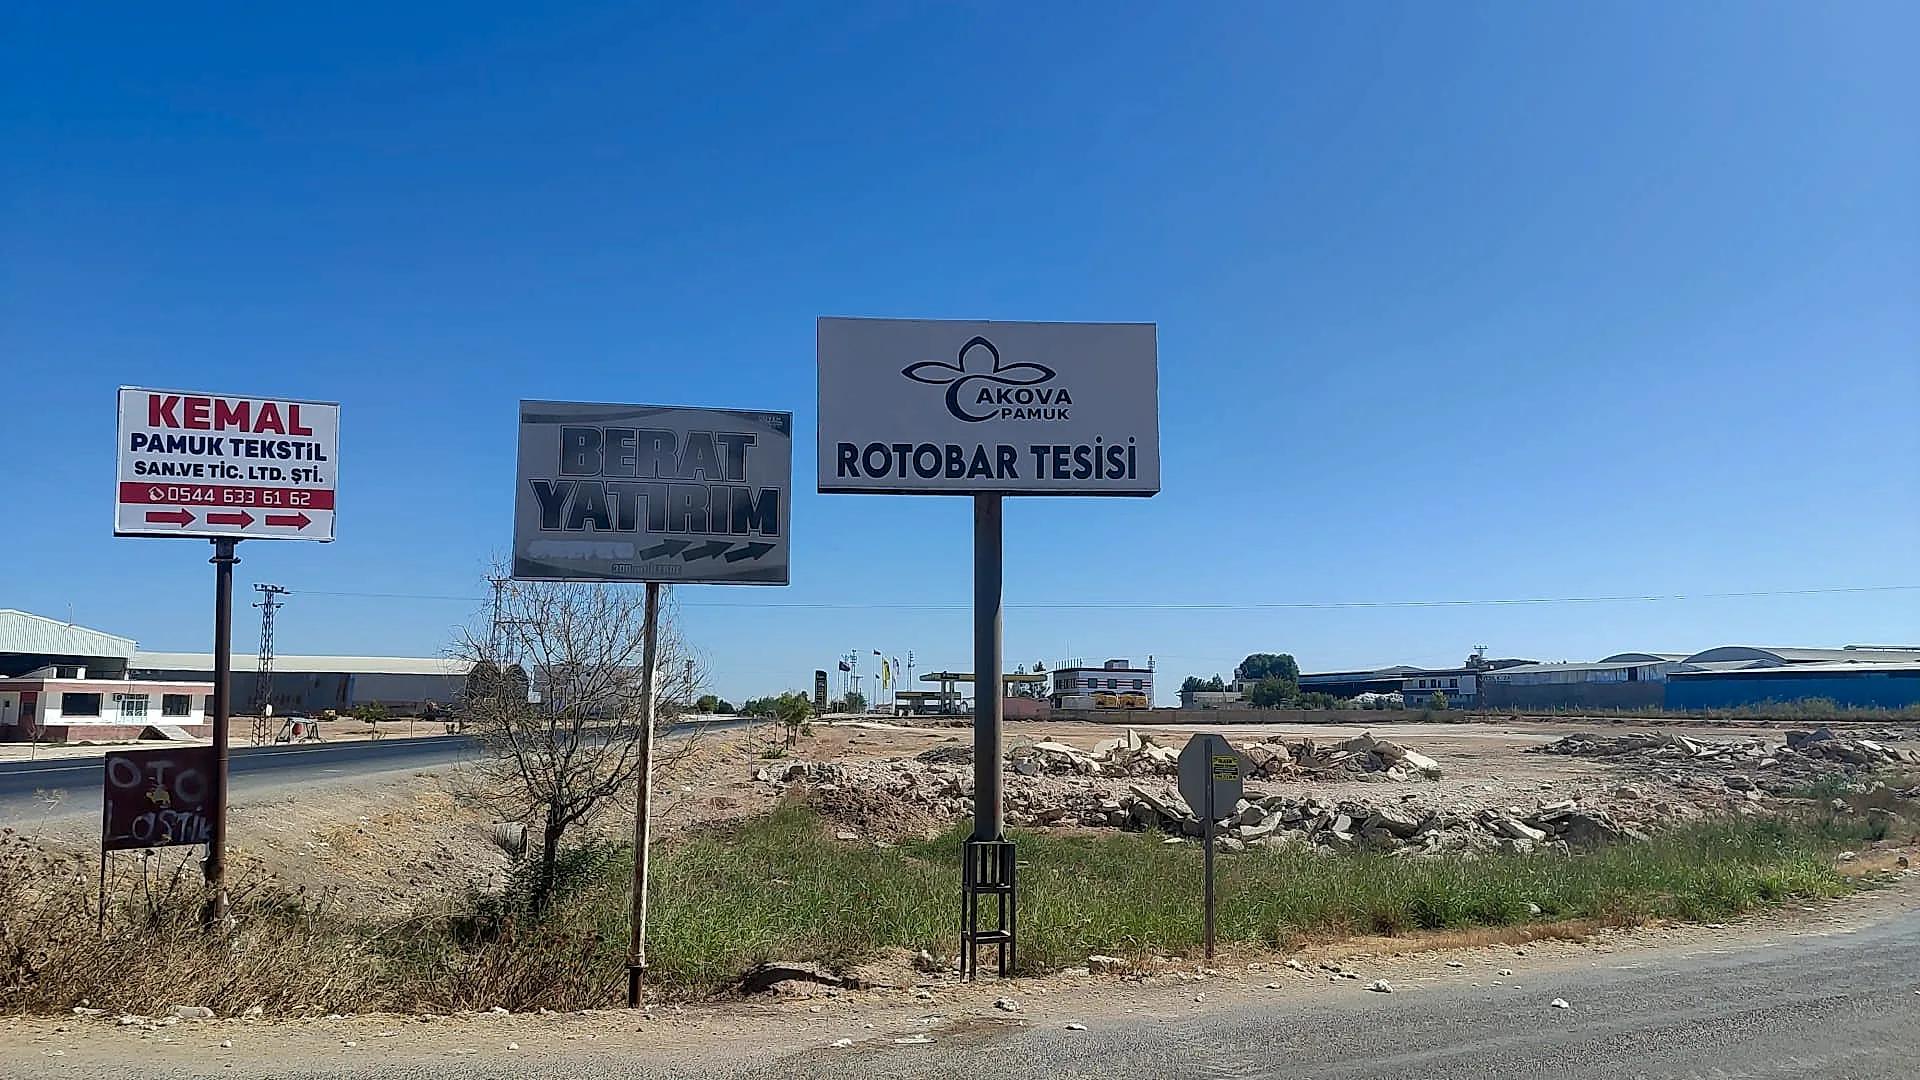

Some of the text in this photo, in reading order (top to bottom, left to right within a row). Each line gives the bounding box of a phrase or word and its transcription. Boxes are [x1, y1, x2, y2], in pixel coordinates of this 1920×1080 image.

[976, 388, 1073, 405] AKOVA
[1001, 408, 1070, 421] PAMUK
[148, 394, 313, 437] KEMAL
[130, 432, 328, 462] PAMUK TEKSTİL
[559, 425, 758, 482] BERAT
[837, 436, 1137, 481] ROTOBAR TESİSİ
[207, 460, 244, 479] TİC.
[248, 466, 287, 481] LTD.
[291, 465, 324, 484] ŞTİ.
[167, 486, 311, 506] 0544 633 61 62
[528, 479, 782, 537] YATIRIM
[108, 757, 206, 803] OTO
